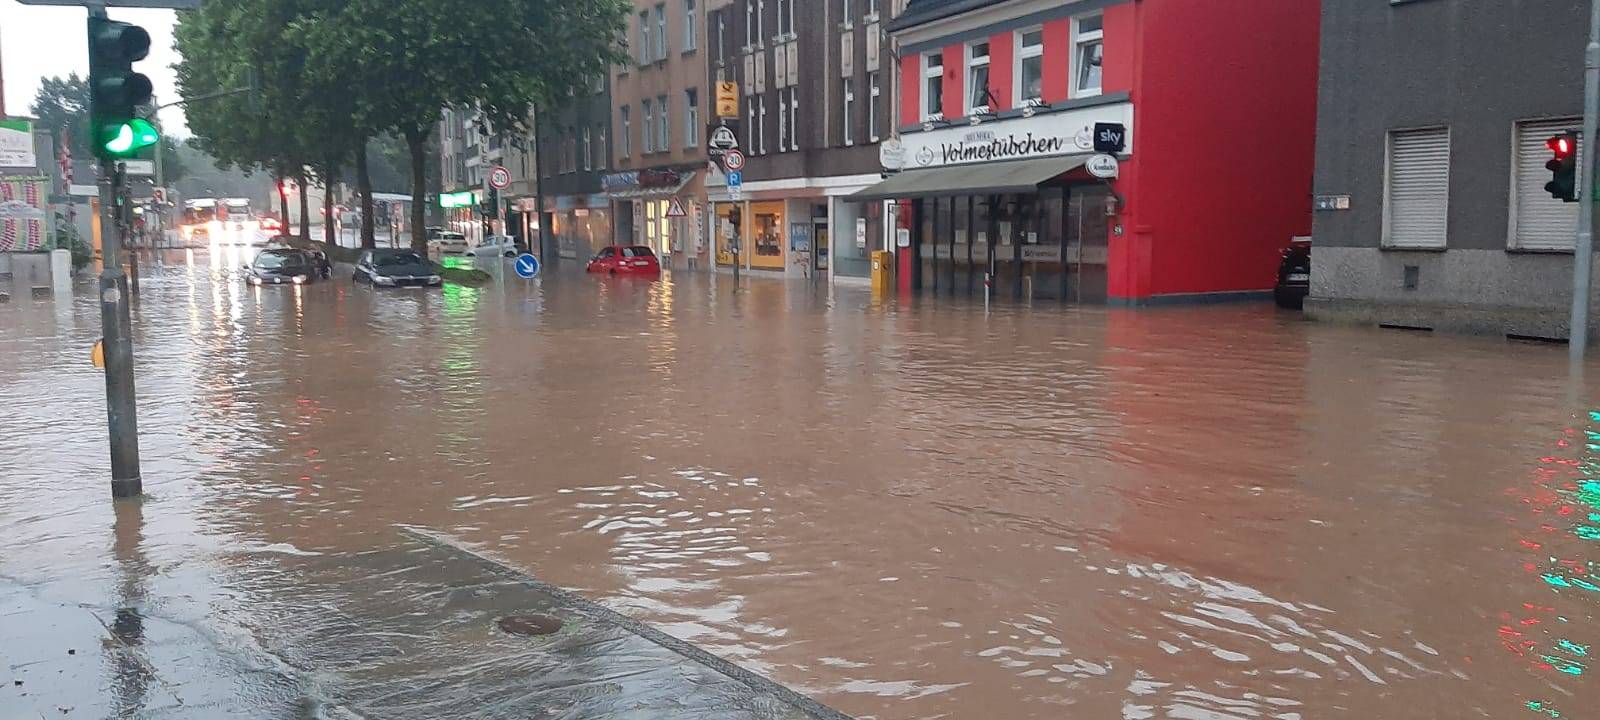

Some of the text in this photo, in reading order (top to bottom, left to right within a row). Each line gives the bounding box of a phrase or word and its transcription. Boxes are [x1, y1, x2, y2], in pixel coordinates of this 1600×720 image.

[1100, 129, 1121, 146] sky
[941, 133, 1063, 164] Volmestübchen
[729, 156, 740, 166] 30
[495, 173, 506, 183] 30
[730, 174, 738, 184] P
